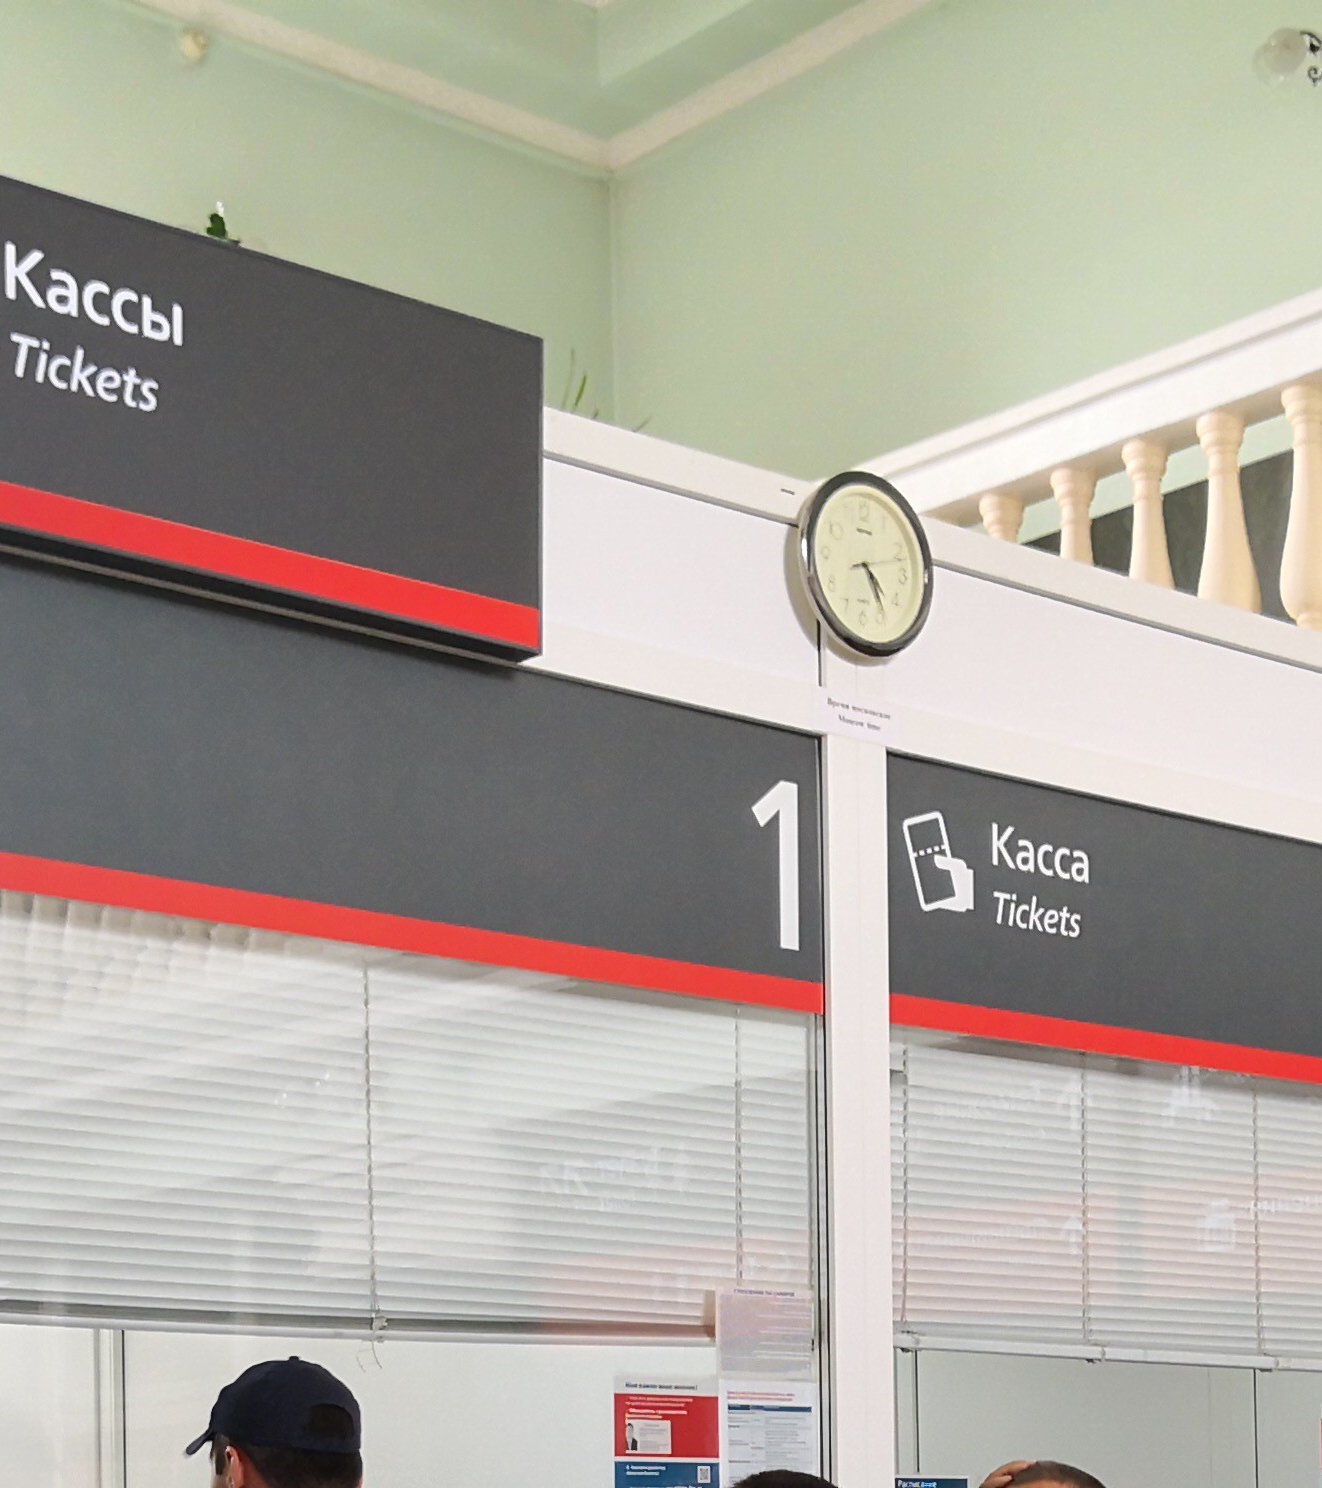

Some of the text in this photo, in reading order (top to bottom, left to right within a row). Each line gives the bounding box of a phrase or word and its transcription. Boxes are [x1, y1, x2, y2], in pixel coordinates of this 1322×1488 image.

[3, 240, 184, 347] Кассы
[9, 332, 159, 412] Tickets
[751, 781, 800, 952] 1
[990, 823, 1090, 885] Касса
[993, 891, 1082, 940] Tickets
